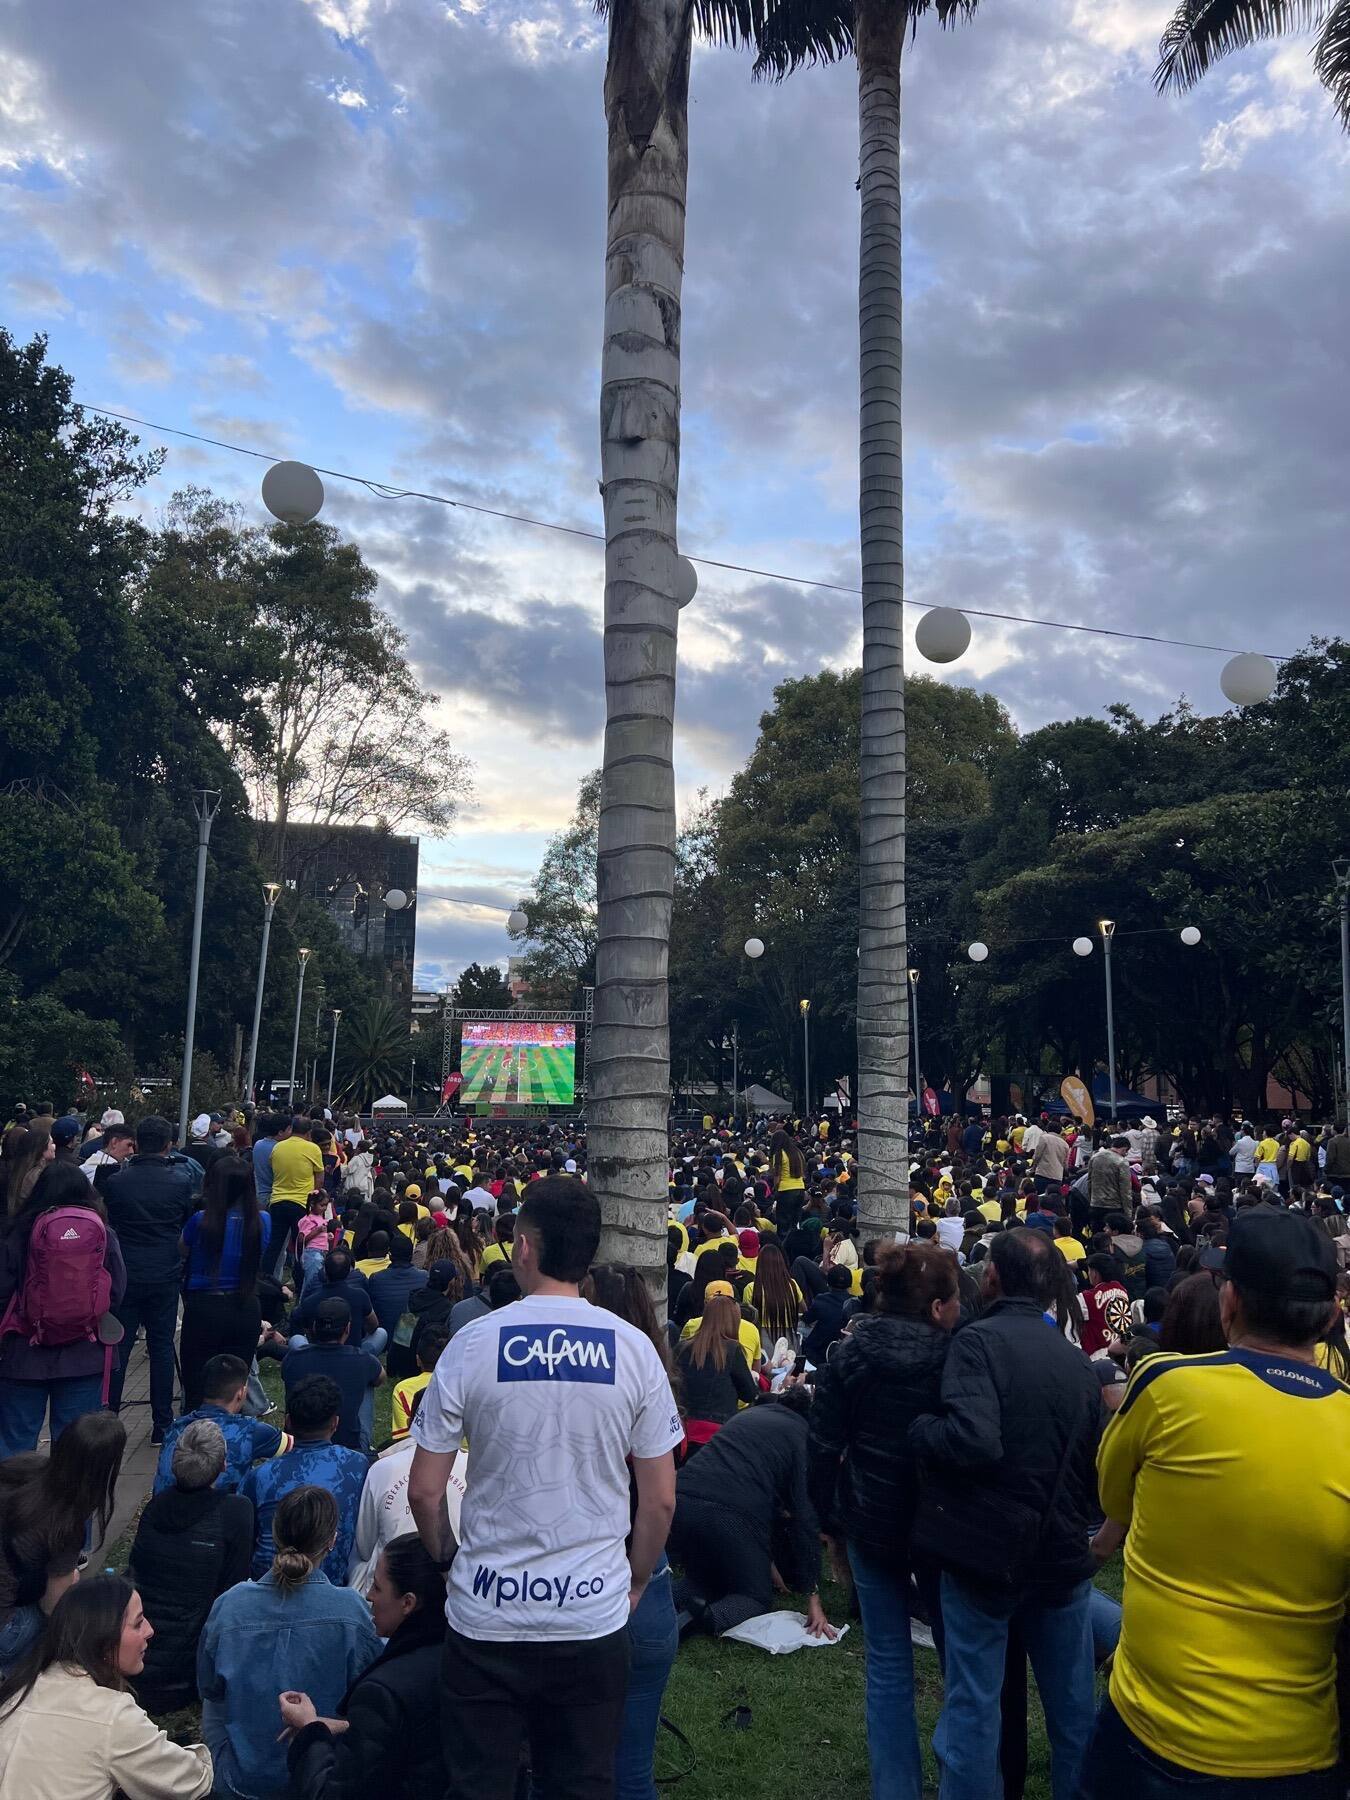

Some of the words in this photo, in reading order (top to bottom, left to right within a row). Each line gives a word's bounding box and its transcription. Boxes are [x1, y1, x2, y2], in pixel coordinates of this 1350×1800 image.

[1266, 1368, 1324, 1389] COLOMBIA
[384, 1474, 410, 1511] FEDERAC
[473, 1564, 604, 1608] Wplay.co
